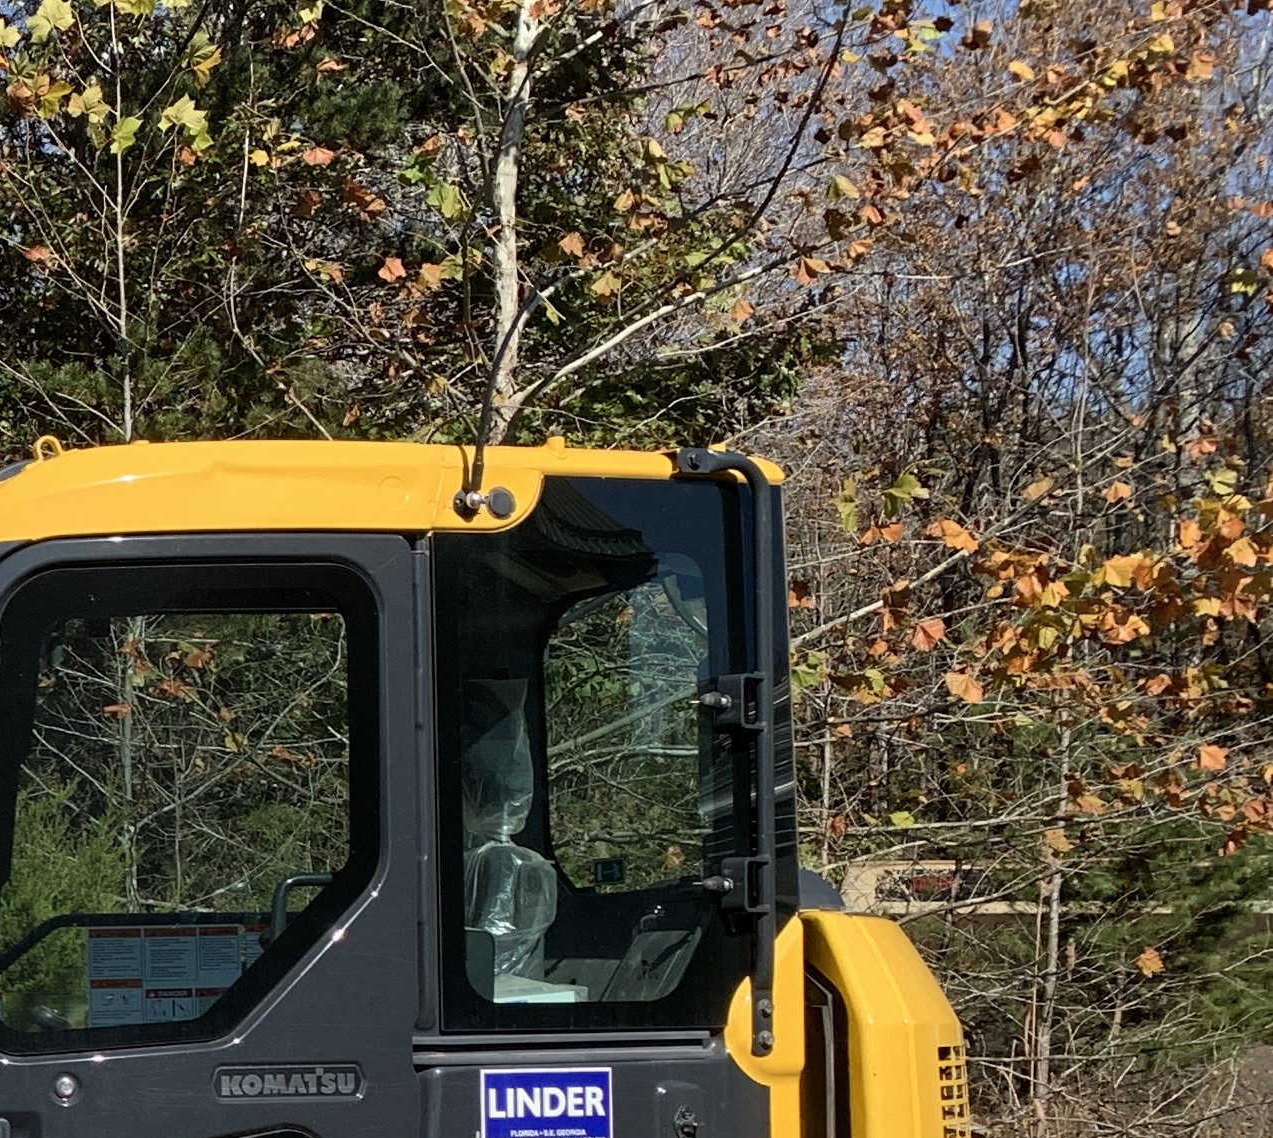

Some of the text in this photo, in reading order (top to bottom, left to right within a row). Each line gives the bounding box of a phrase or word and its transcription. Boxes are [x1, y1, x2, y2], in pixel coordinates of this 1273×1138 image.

[221, 1067, 356, 1096] KOMATSU
[488, 1086, 606, 1118] LINDER
[510, 1129, 539, 1137] FLORIDA
[556, 1128, 587, 1136] GEORGIA
